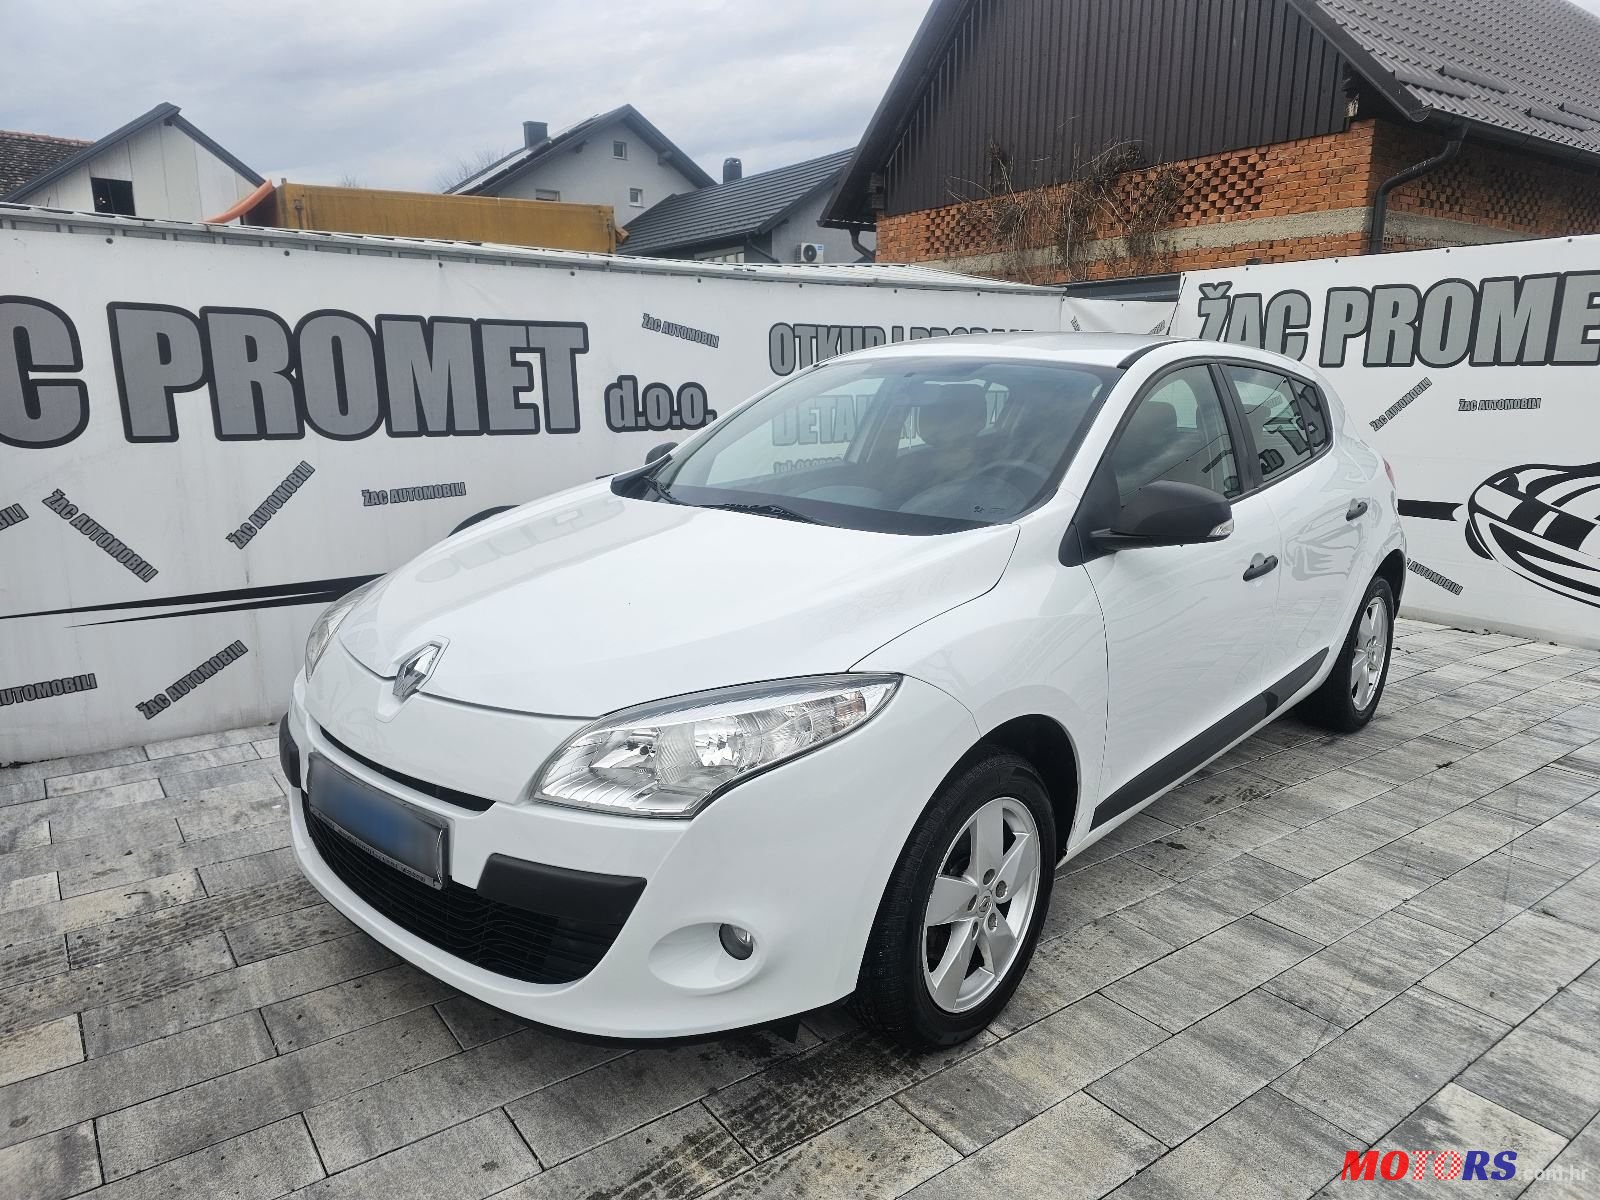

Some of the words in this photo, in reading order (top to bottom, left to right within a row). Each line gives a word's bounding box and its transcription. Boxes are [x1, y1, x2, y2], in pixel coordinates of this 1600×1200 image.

[642, 313, 661, 332] ŽAC
[661, 321, 719, 348] AUTOMOBILI
[1199, 281, 1311, 361] ŽAC
[107, 301, 589, 443] PROMET
[604, 374, 718, 433] d.o.o.
[1369, 414, 1388, 432] ŽAC
[1385, 376, 1433, 420] AUTOMOBILI
[1458, 398, 1478, 411] ŽAC
[1478, 397, 1541, 411] AUTOMOBILI
[225, 522, 257, 550] ŽAC
[248, 460, 316, 529] AUTOMOBILI
[361, 489, 389, 507] ŽAC
[389, 481, 467, 503] AUTOMOBILI
[41, 488, 79, 520] ŽAC
[69, 512, 159, 583] AUTOMOBILI
[1407, 560, 1464, 596] AUTOMOBILI
[0, 673, 98, 706] UTOMOBILI
[135, 693, 171, 720] ŽAC
[165, 639, 248, 702] AUTOMOBILI
